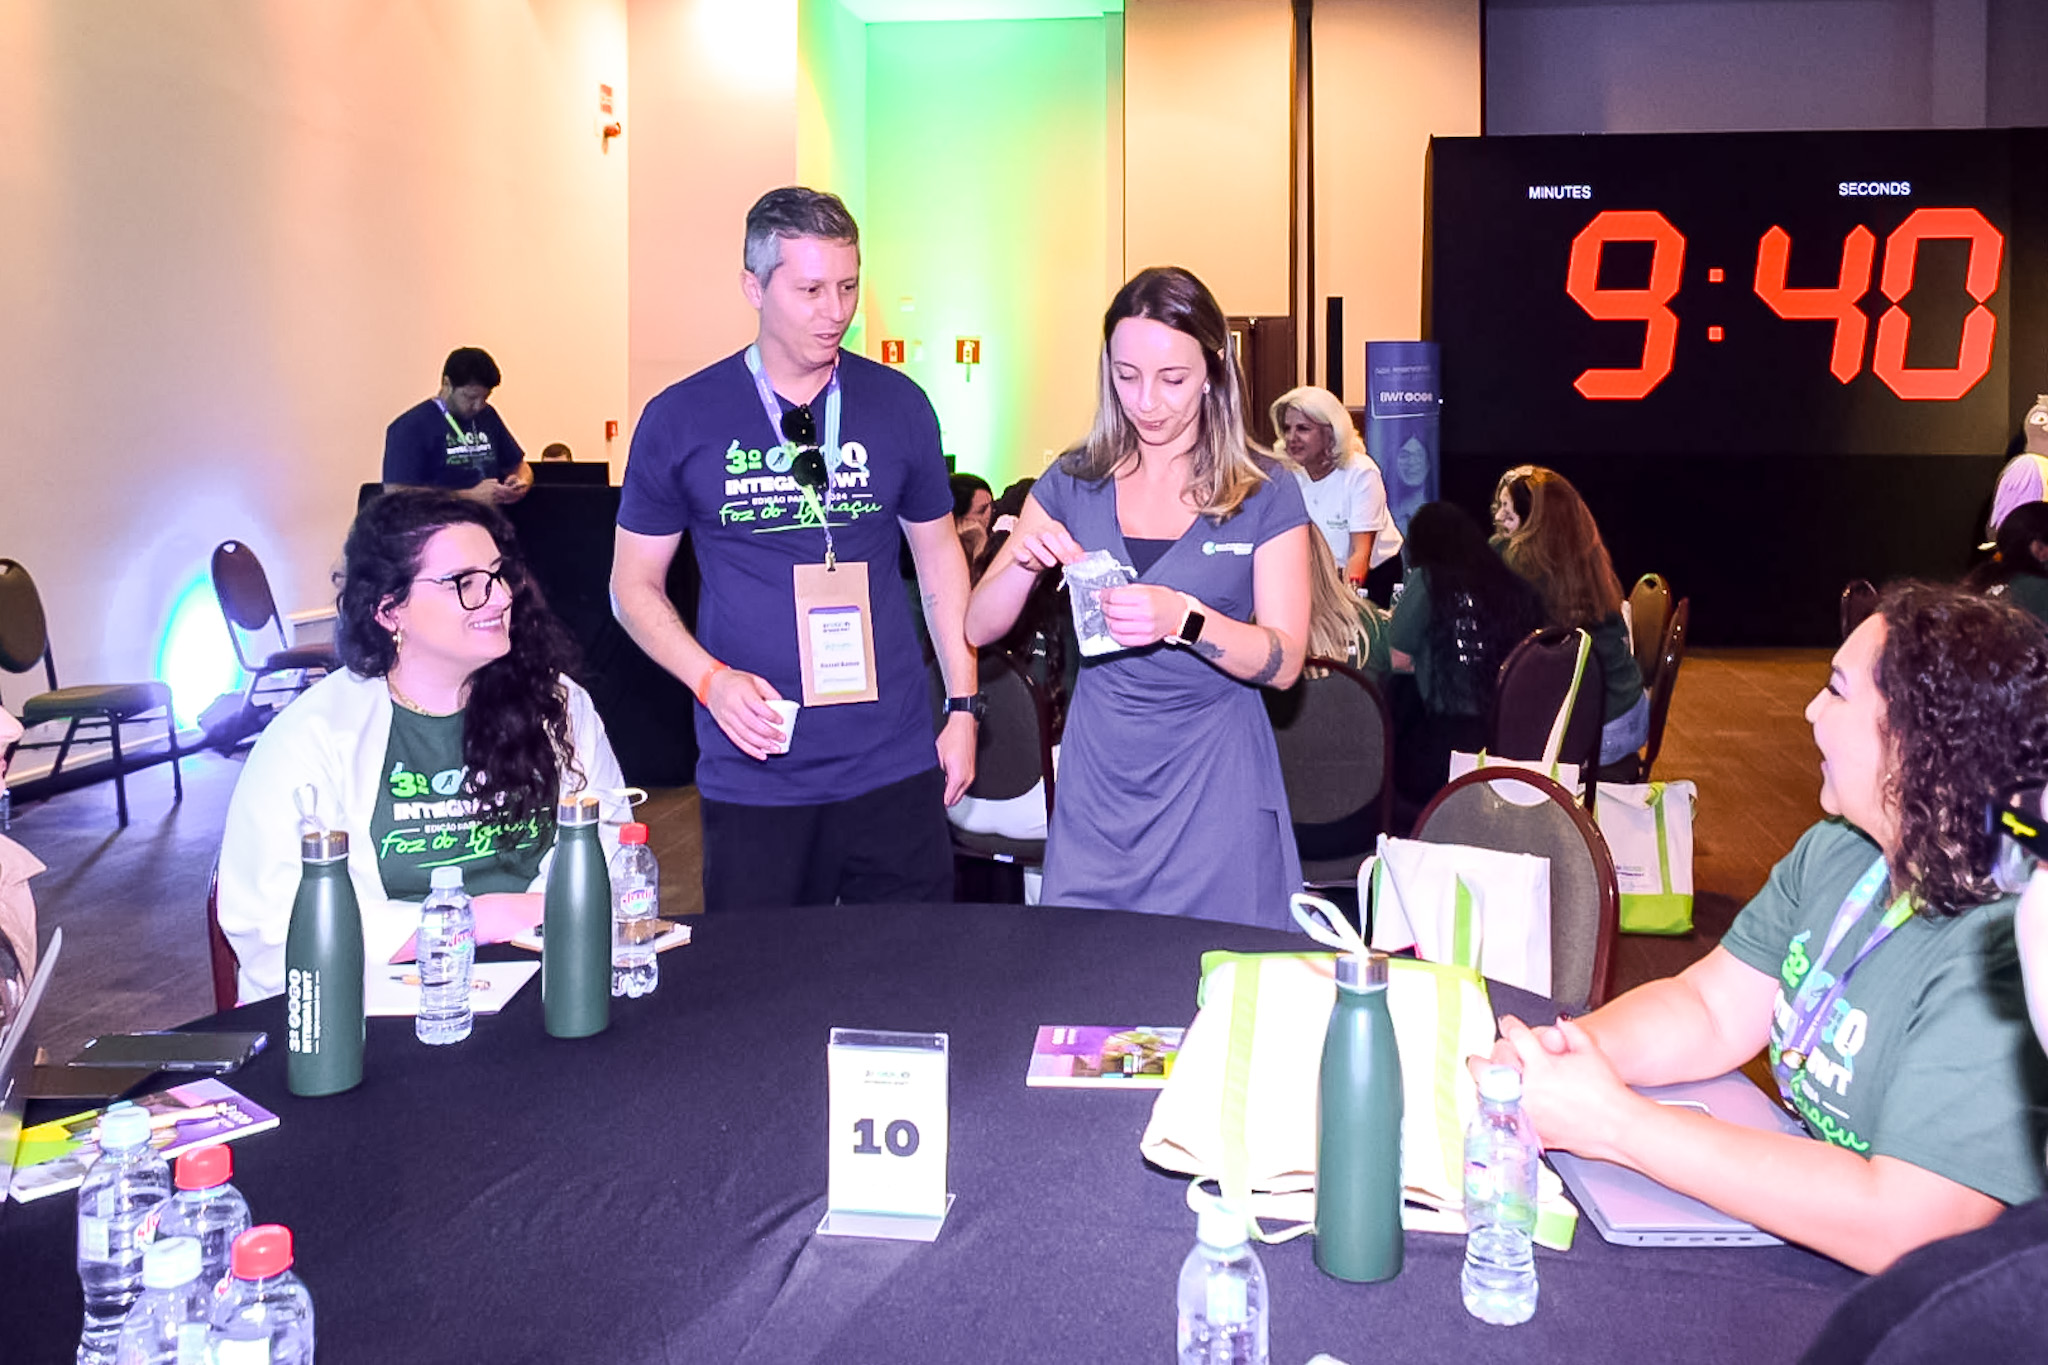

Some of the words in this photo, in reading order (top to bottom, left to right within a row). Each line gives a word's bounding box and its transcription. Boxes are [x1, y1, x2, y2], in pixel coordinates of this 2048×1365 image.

[1528, 185, 1592, 200] MINUTES
[1838, 181, 1911, 197] SECONDS
[1566, 207, 2005, 402] 9:40
[719, 501, 756, 526] Foz
[761, 500, 788, 519] do
[381, 829, 427, 859] Foz
[432, 826, 459, 850] do
[853, 1117, 920, 1157] 10
